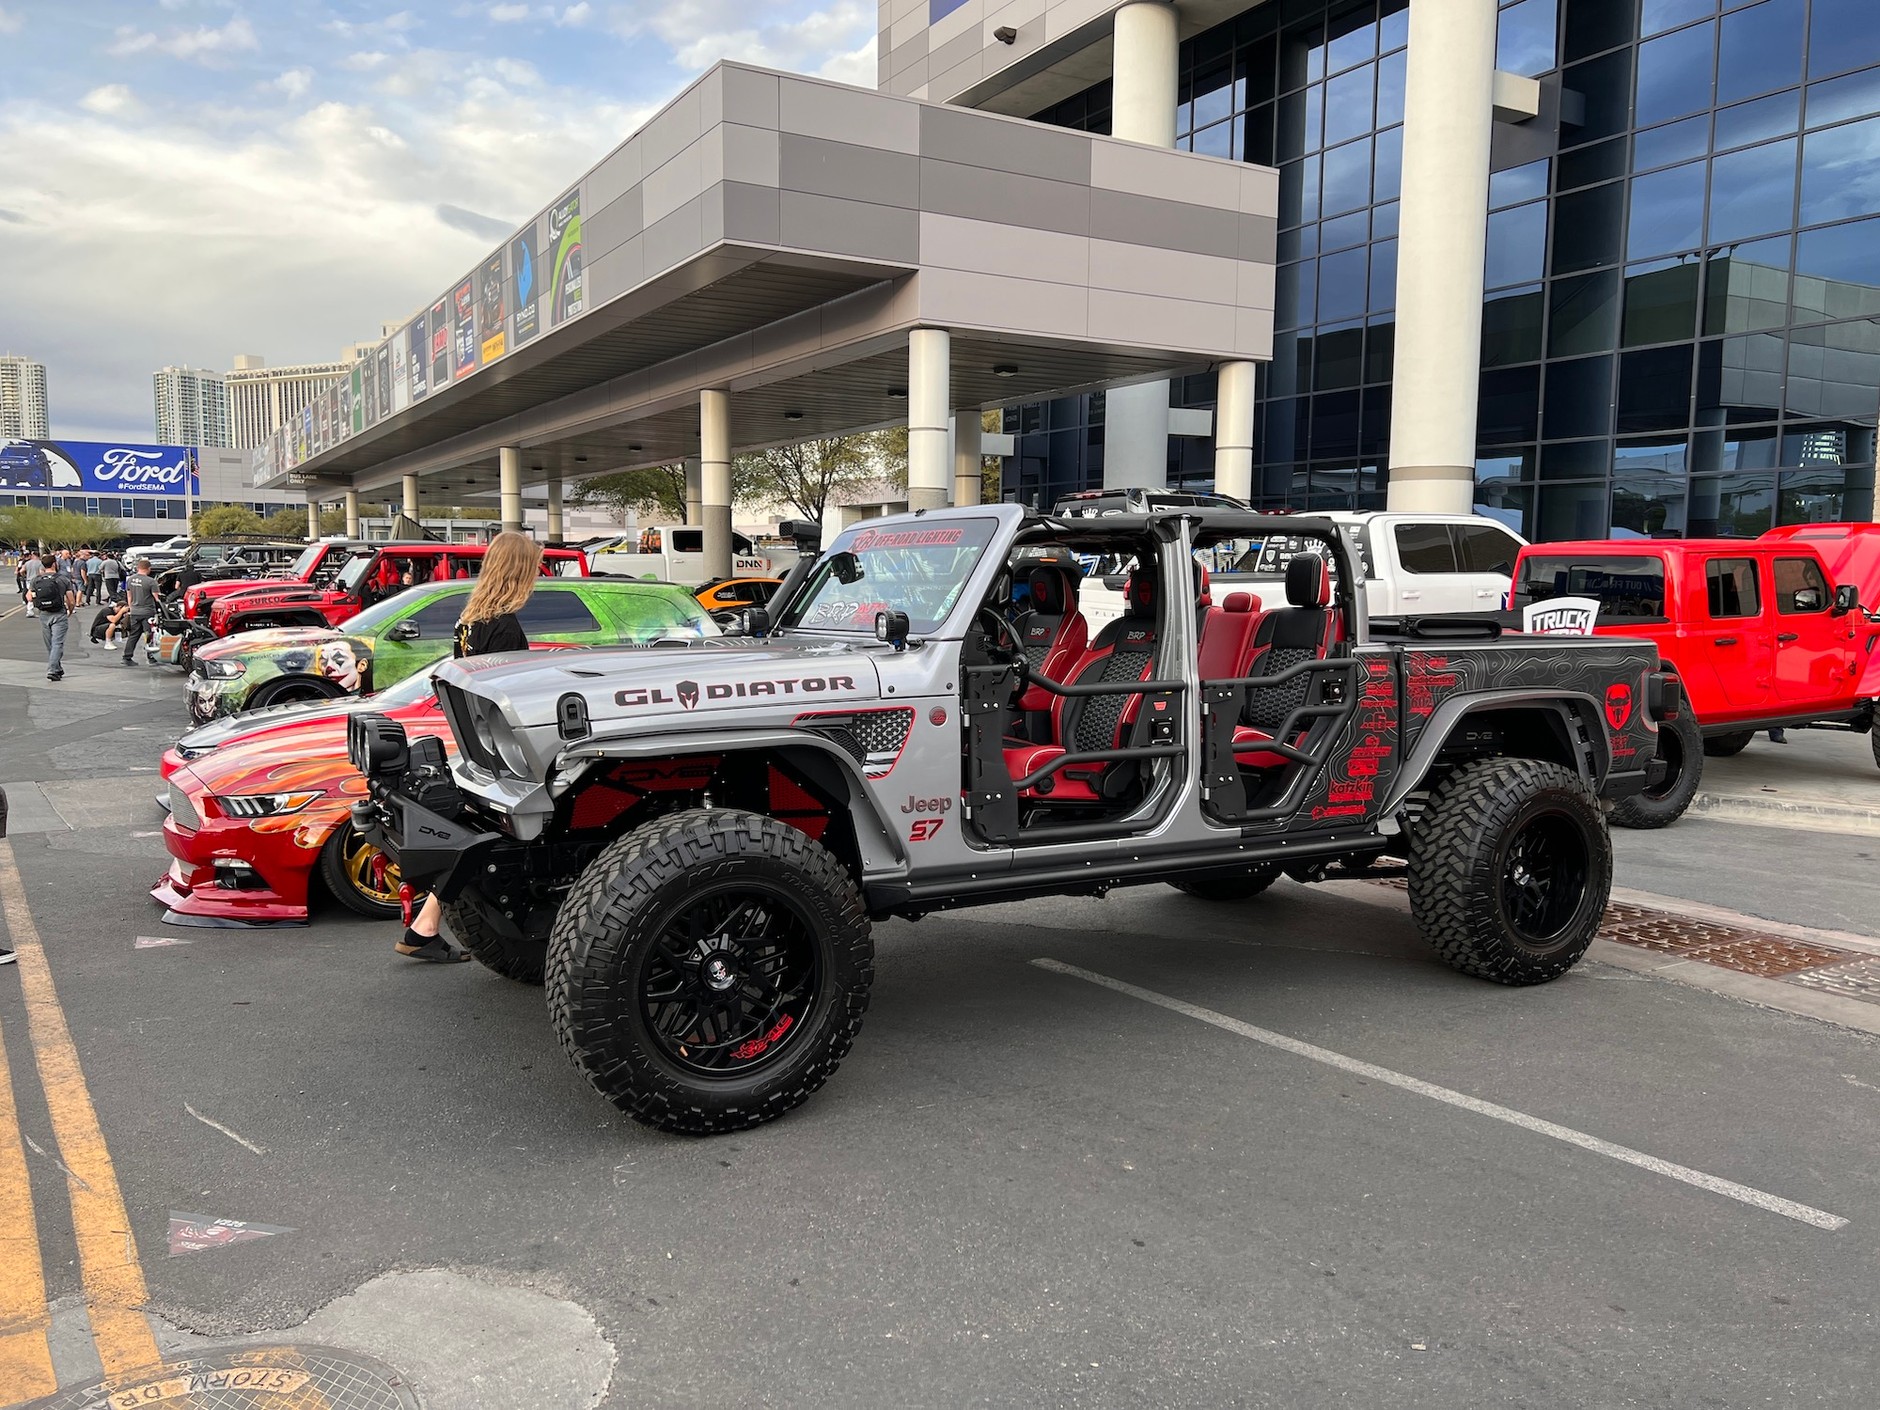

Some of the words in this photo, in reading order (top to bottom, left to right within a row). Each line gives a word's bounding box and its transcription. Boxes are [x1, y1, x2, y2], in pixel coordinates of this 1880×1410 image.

[93, 448, 185, 484] Ford
[117, 483, 166, 491] #FordSEMA
[914, 529, 962, 544] LIGHTING
[736, 560, 763, 568] DNA
[249, 596, 281, 605] SURCO
[1532, 610, 1590, 629] TRUCK
[1330, 780, 1374, 793] katzkin
[900, 796, 952, 814] Jeep
[188, 1370, 294, 1392] STORM
